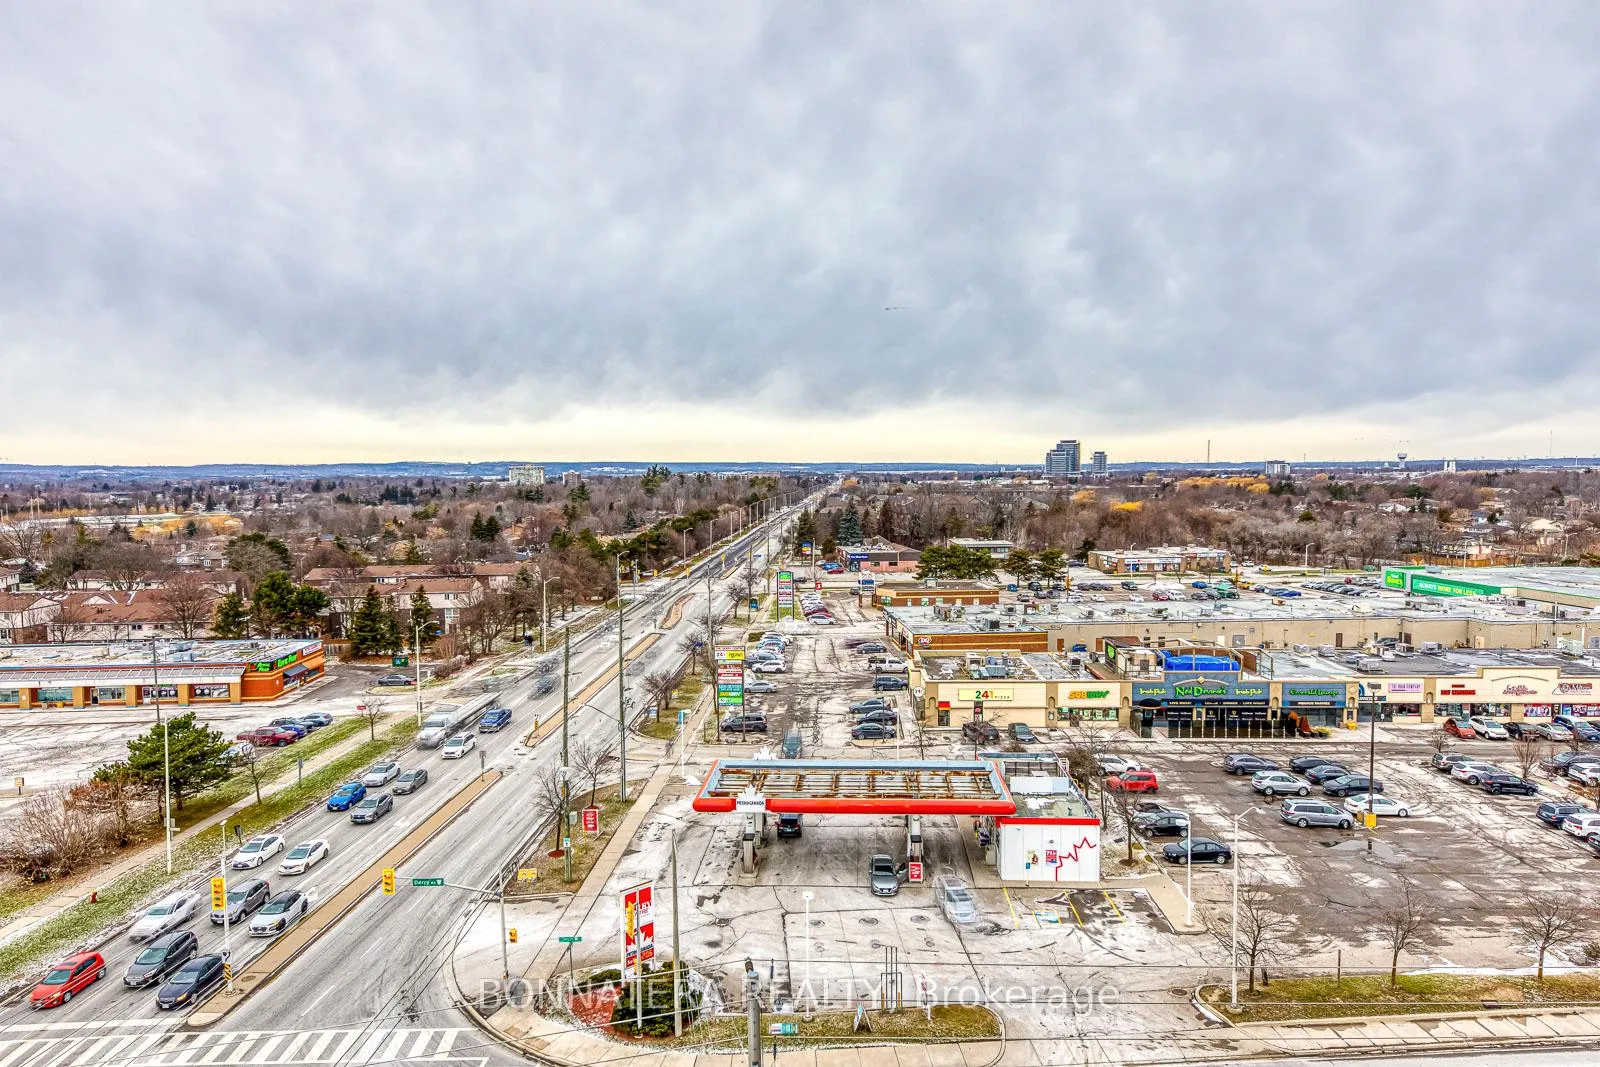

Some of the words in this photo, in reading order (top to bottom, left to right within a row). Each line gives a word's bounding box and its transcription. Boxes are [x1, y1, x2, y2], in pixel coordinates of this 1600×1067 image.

[975, 690, 993, 699] 241
[1068, 690, 1110, 700] SUBWAY
[1175, 686, 1193, 698] Ned
[1290, 688, 1317, 696] Emerald
